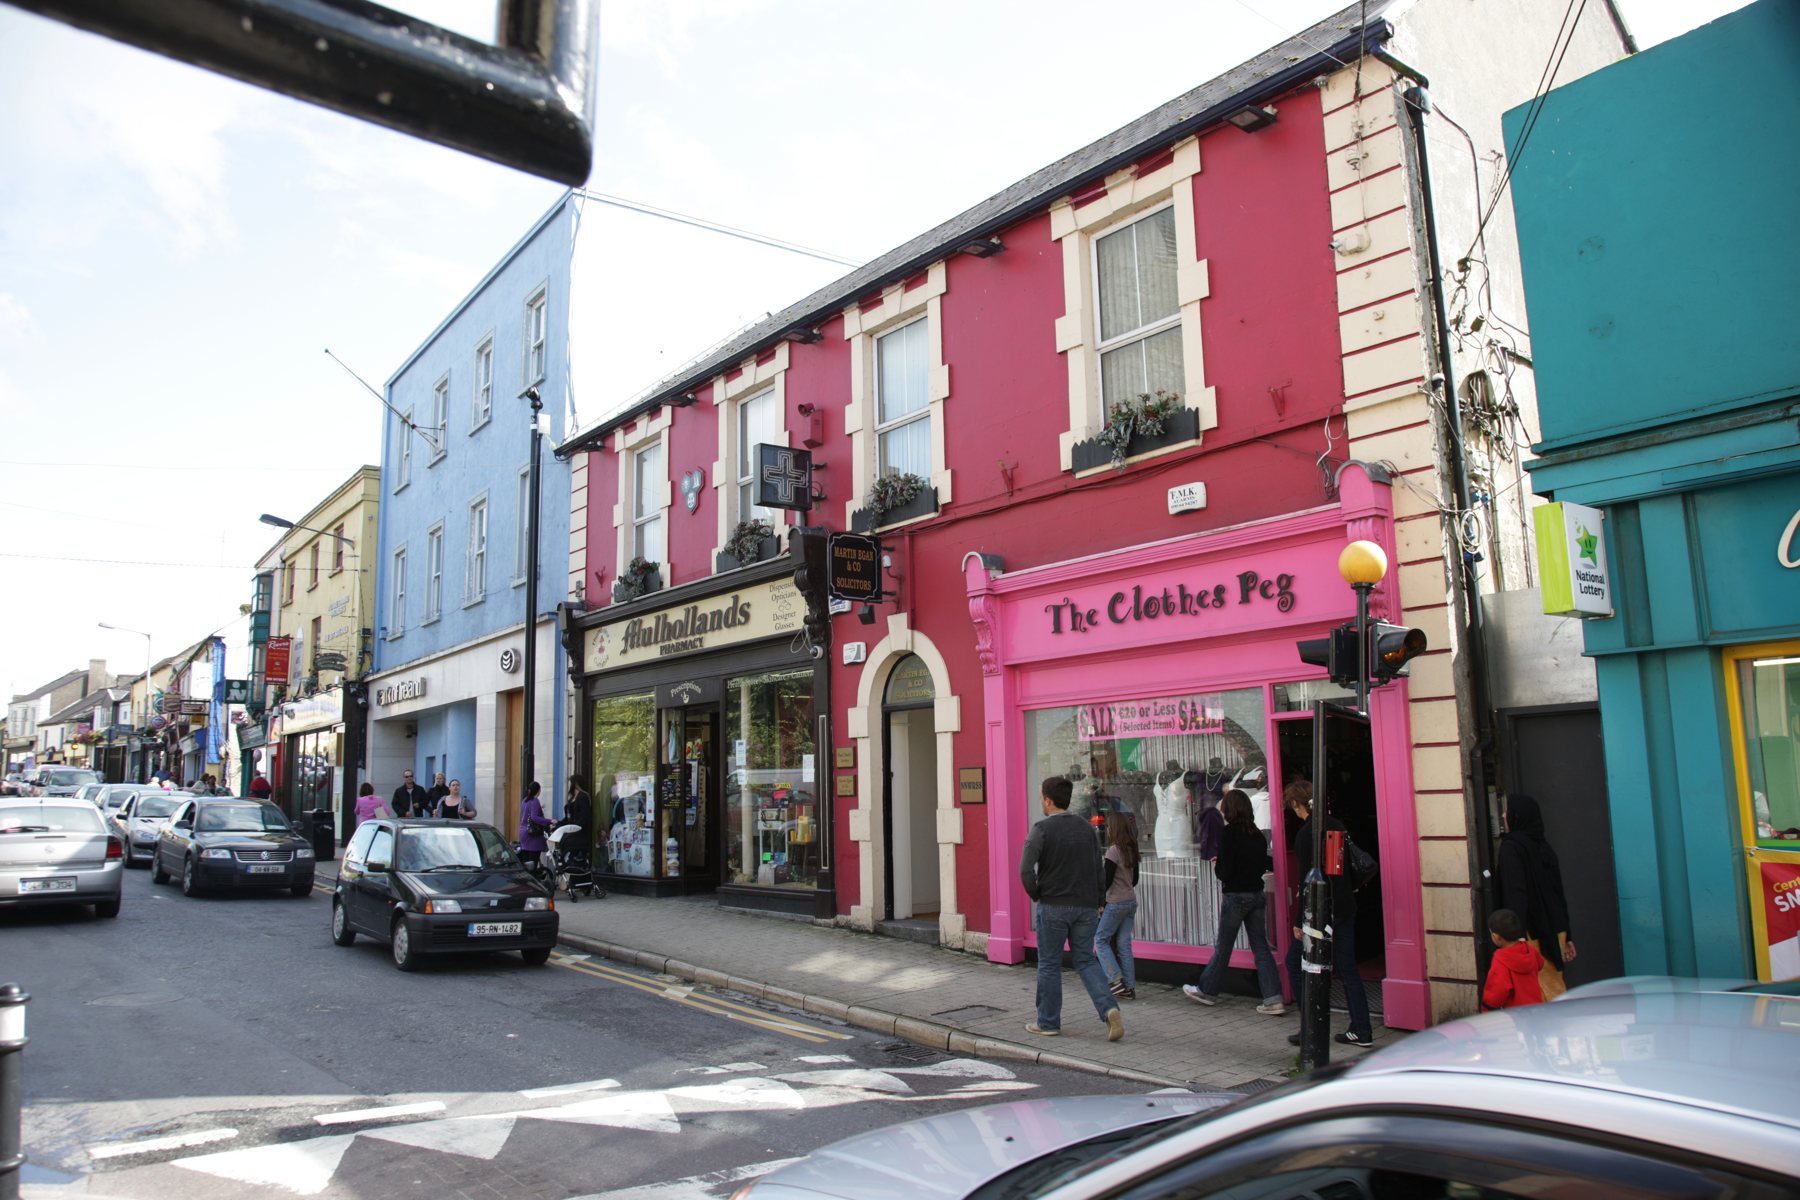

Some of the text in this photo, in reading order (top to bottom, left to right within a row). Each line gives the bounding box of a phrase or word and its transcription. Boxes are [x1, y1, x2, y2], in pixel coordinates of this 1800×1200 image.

[834, 546, 874, 561] MARTIN EGAN
[847, 561, 861, 572] & CO
[836, 577, 872, 591] SOLICITORS
[1575, 569, 1605, 584] National
[771, 590, 797, 603] Opticians
[1579, 582, 1605, 600] Lottery
[1044, 570, 1295, 634] The Clothes Peg
[772, 611, 796, 622] Designer
[620, 594, 751, 656] Mulhollands
[774, 622, 795, 631] Glasses
[659, 637, 704, 656] PHARMACY
[670, 681, 702, 697] Prescriptions
[1139, 706, 1151, 717] or
[1153, 701, 1176, 716] Less
[1080, 706, 1117, 737] SALE
[1120, 718, 1176, 732] (Selected Items)
